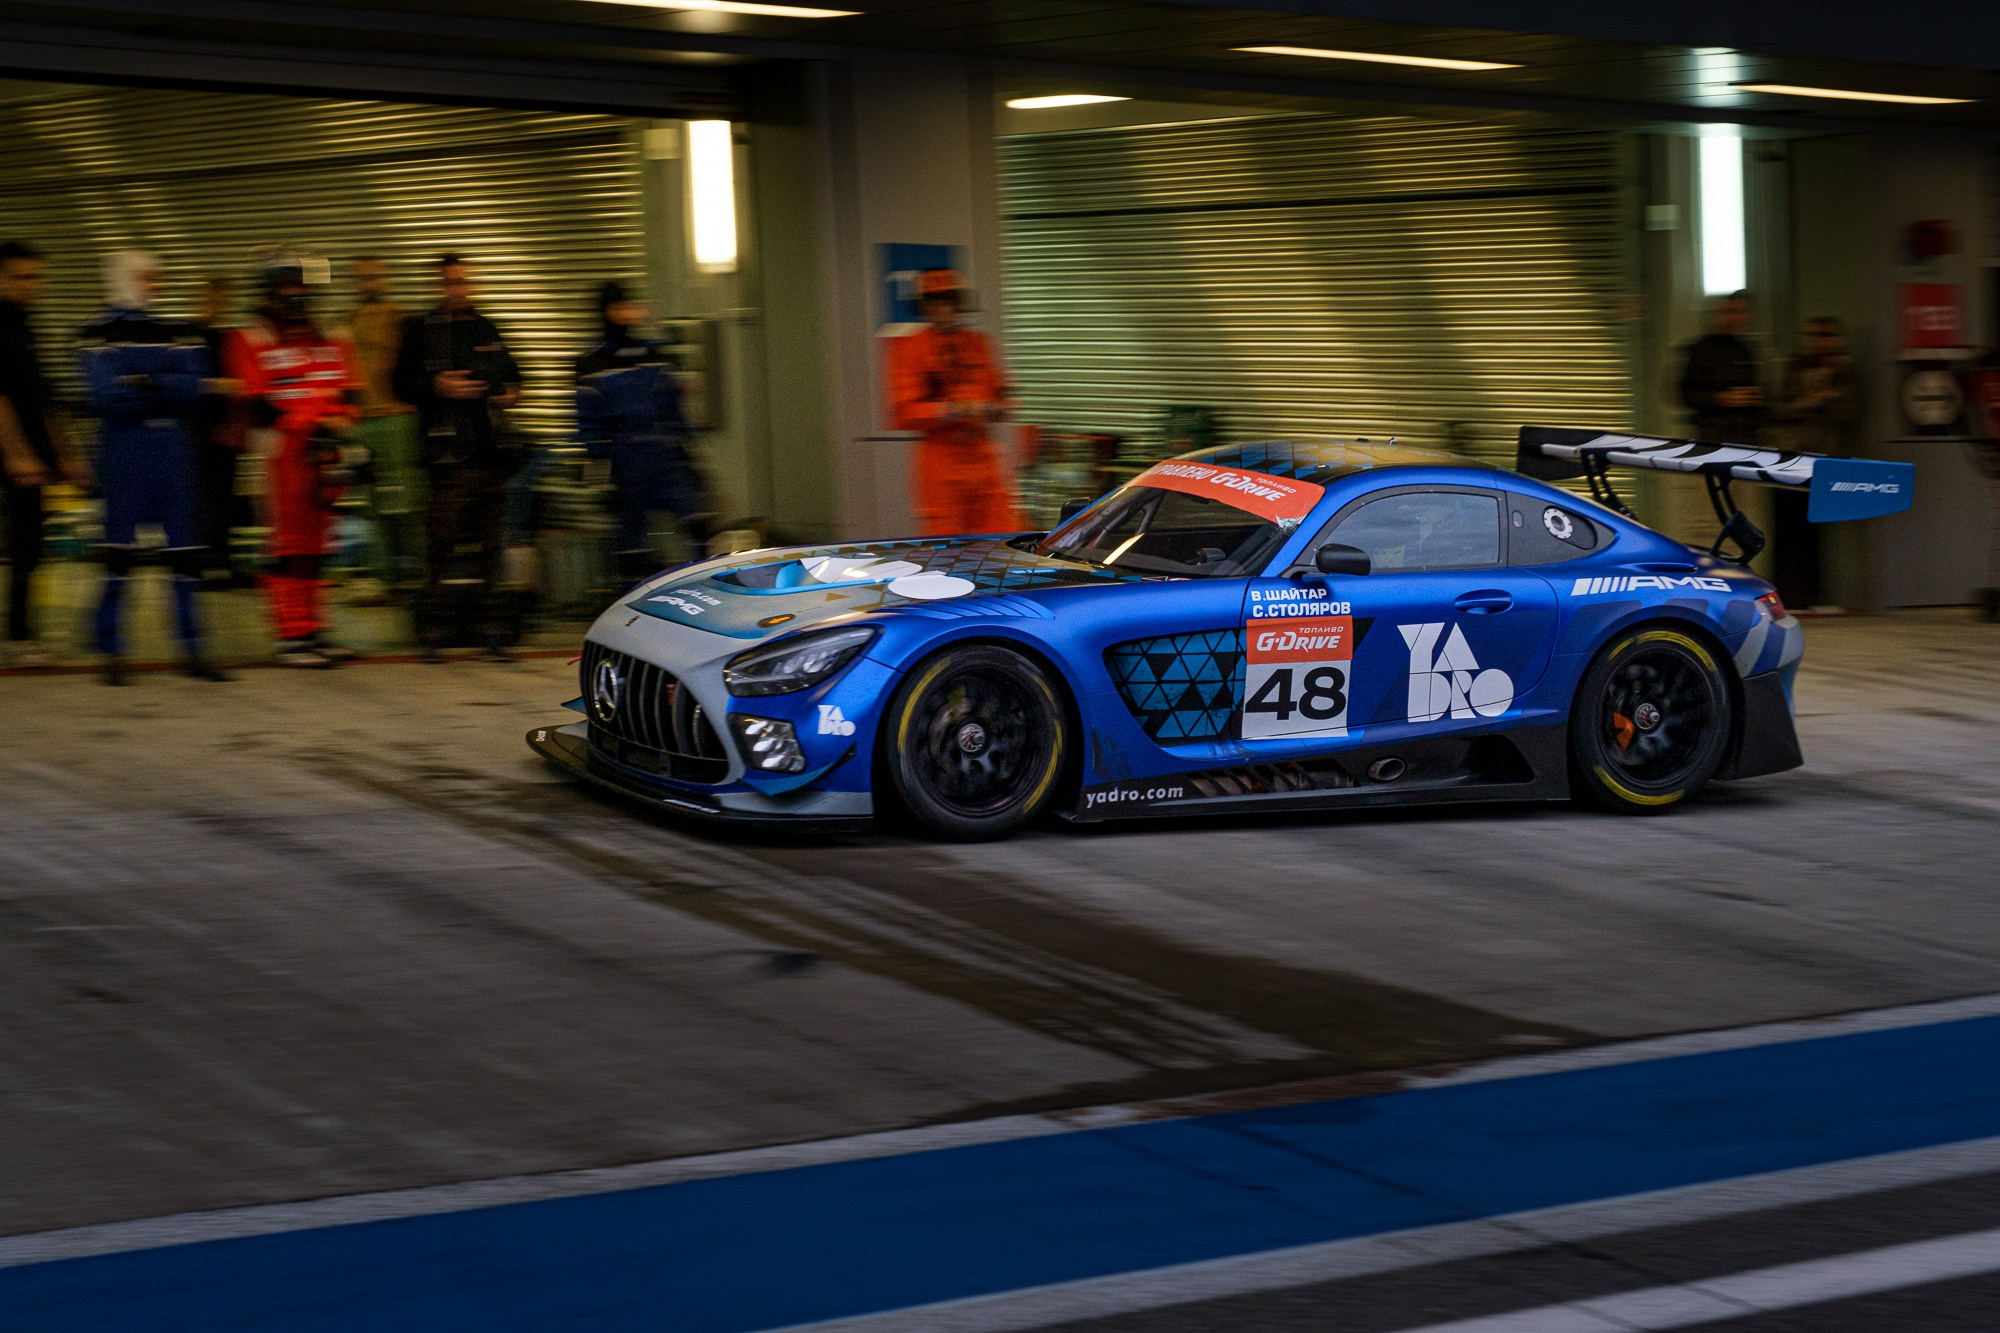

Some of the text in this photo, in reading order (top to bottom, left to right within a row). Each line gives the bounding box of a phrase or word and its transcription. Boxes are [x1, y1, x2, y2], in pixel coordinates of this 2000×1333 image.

[1251, 587, 1327, 601] В.ШАЙТАР
[1252, 601, 1351, 618] С.СТОЛЯРОВ
[1299, 626, 1344, 634] ТОПЛИВО
[1244, 666, 1346, 721] 48
[1086, 786, 1183, 809] yadro.com
